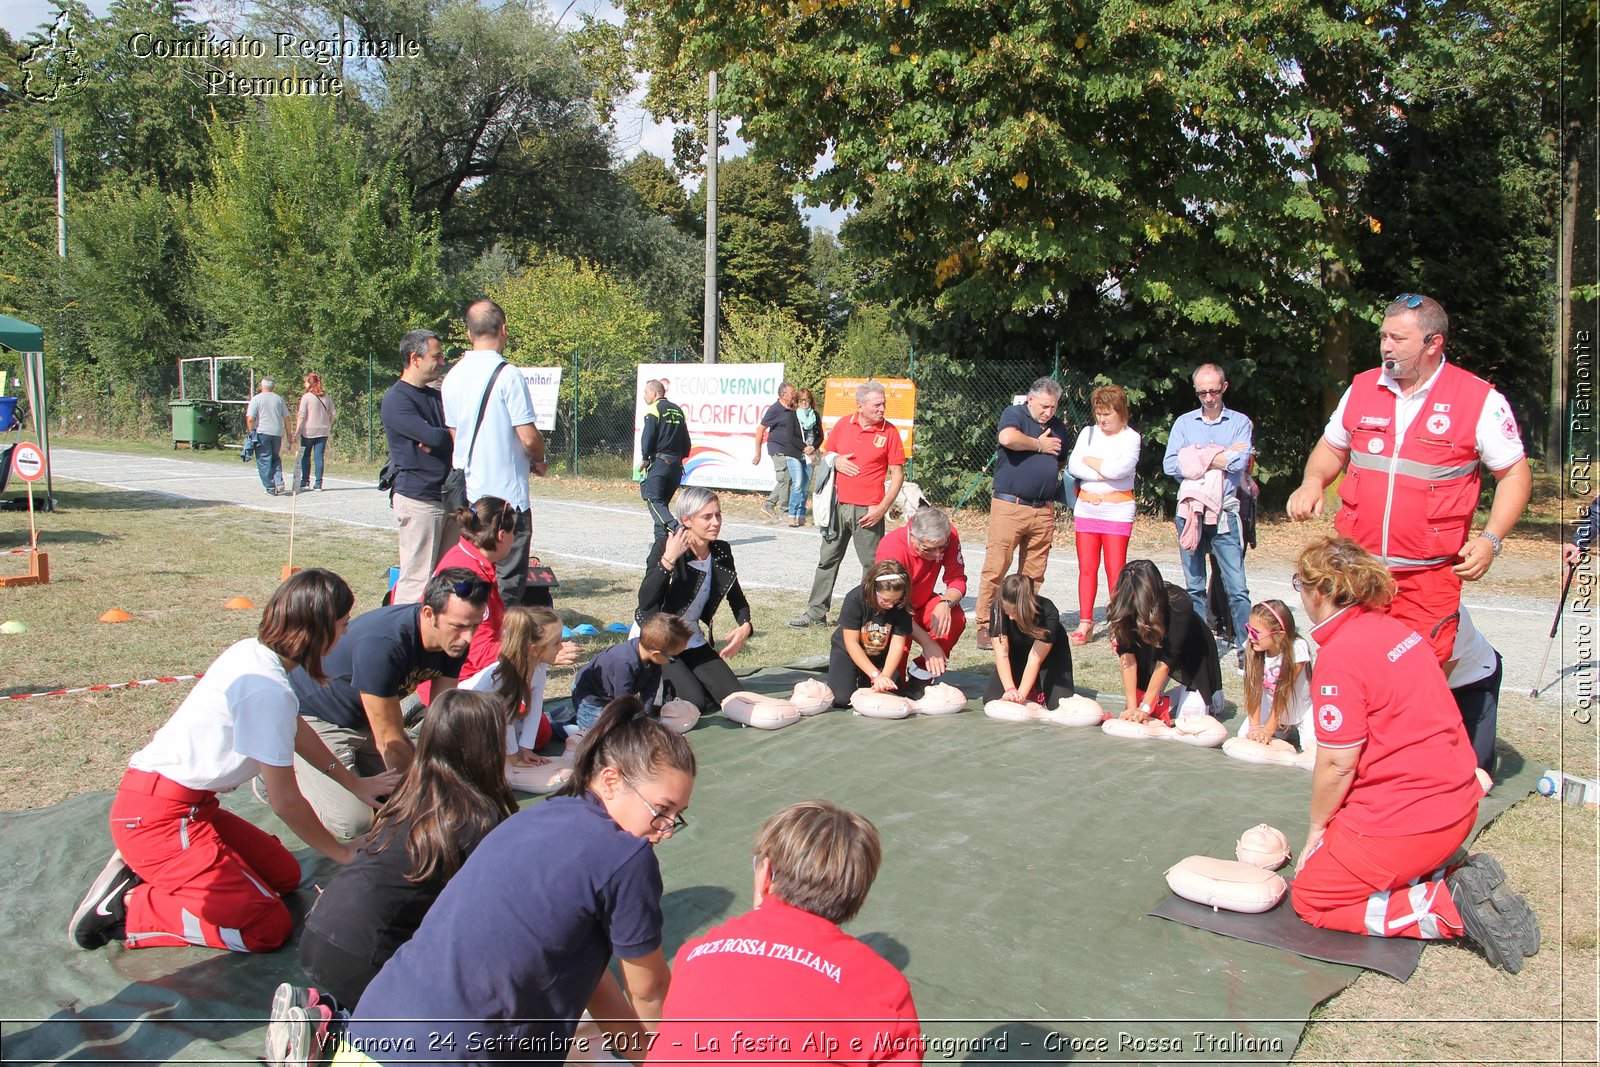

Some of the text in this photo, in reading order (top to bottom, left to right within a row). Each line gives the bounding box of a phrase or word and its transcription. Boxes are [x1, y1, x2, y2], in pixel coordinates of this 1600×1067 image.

[674, 377, 776, 395] TECNOVERNICI
[719, 938, 766, 956] ROSSA
[766, 943, 842, 984] ITALIANA
